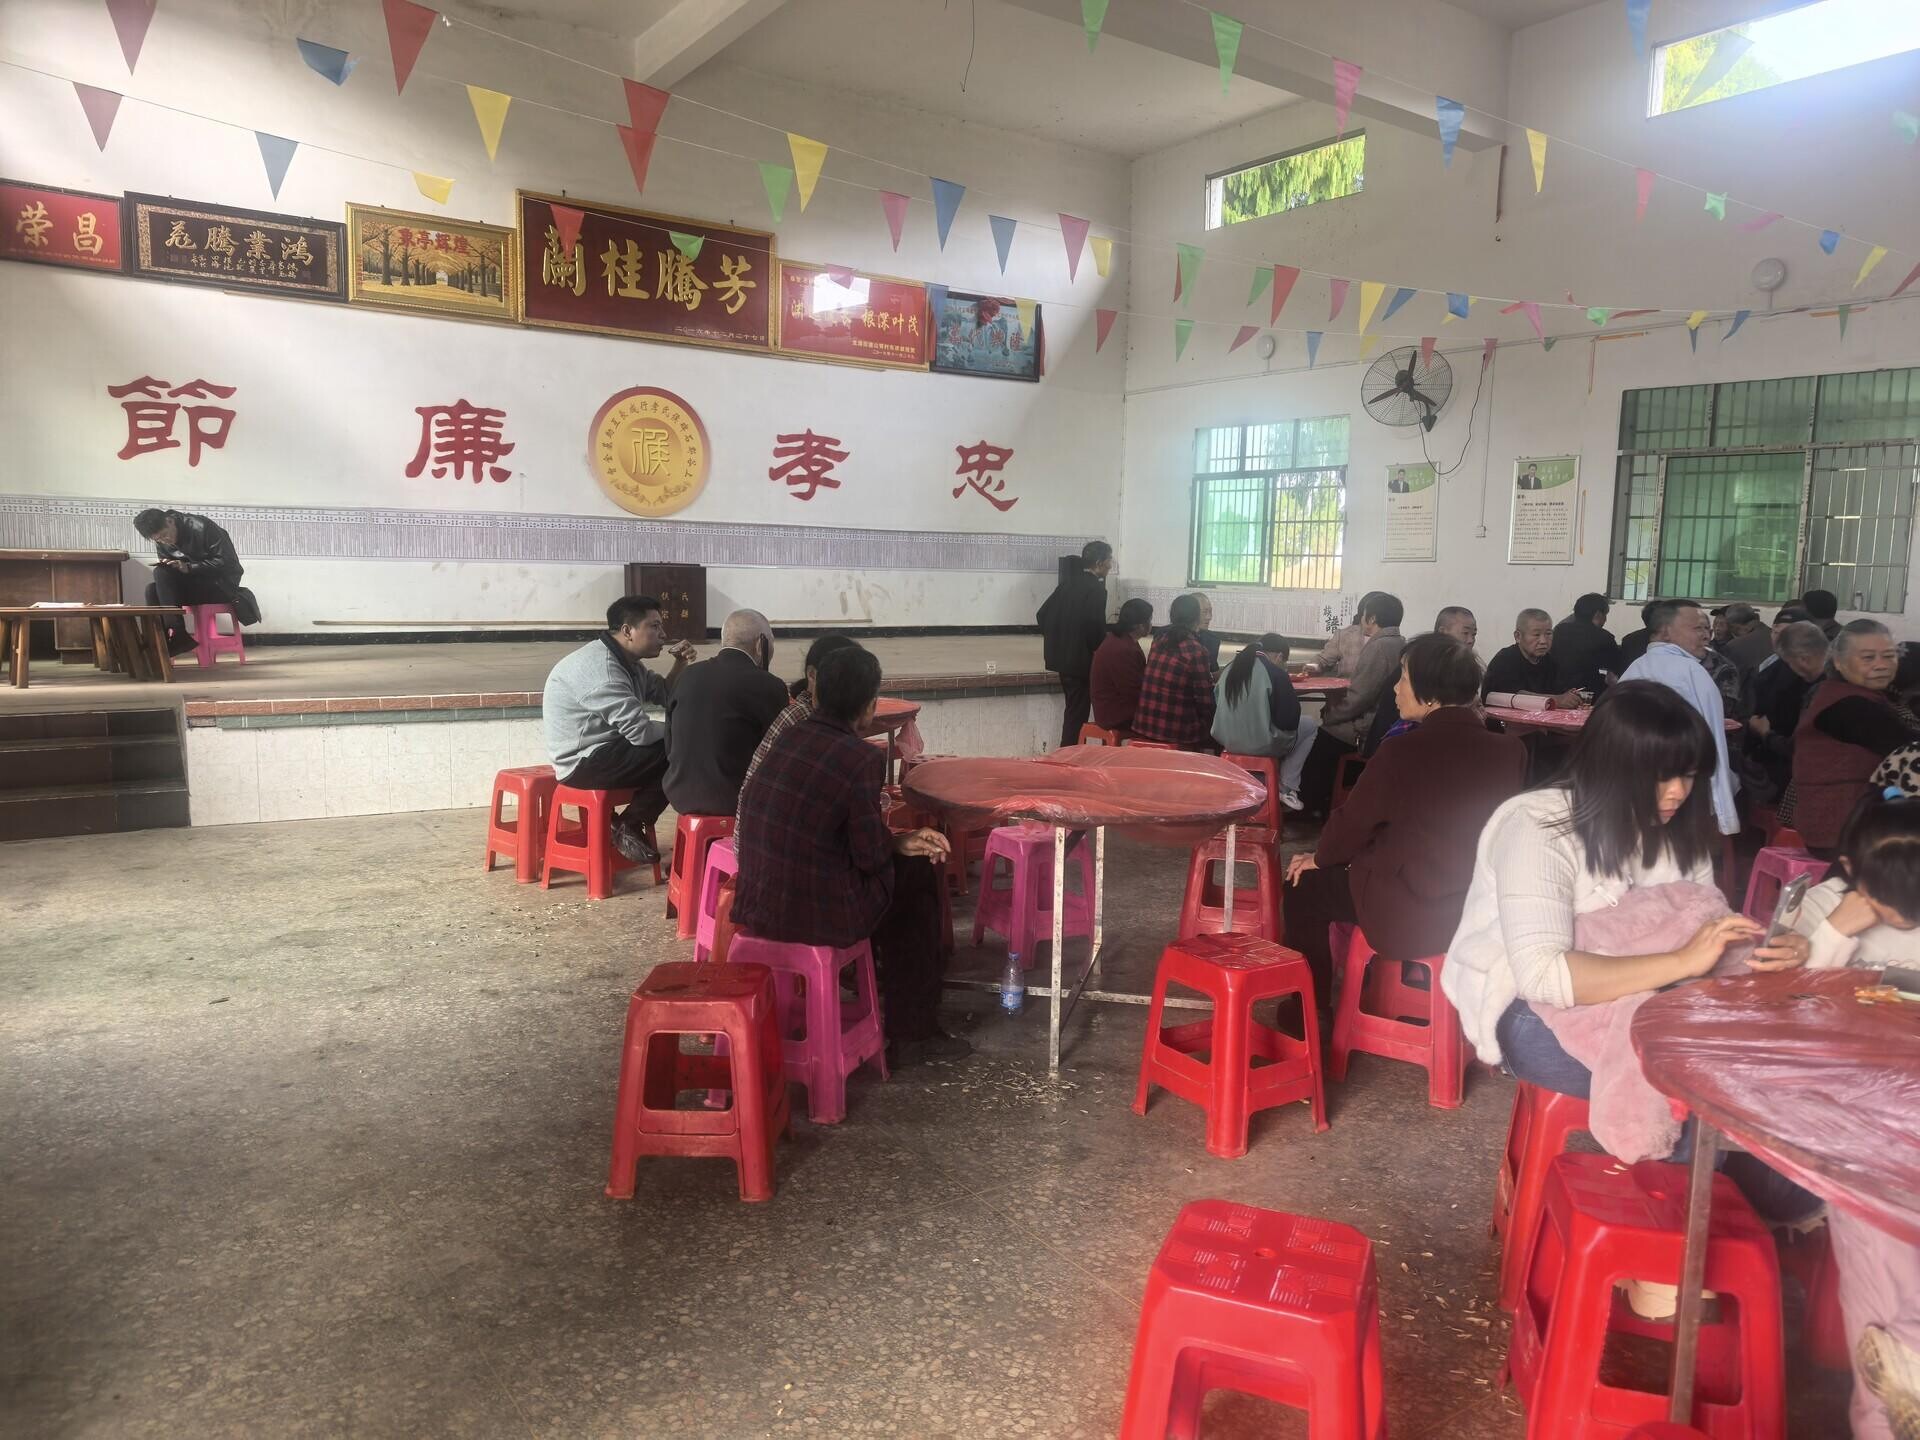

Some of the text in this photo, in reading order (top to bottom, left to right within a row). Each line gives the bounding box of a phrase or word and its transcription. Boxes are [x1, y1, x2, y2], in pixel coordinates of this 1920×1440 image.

[15, 200, 104, 256] 荣昌
[405, 398, 515, 484] 廉
[769, 428, 851, 501] 孝
[952, 440, 1019, 511] 忠
